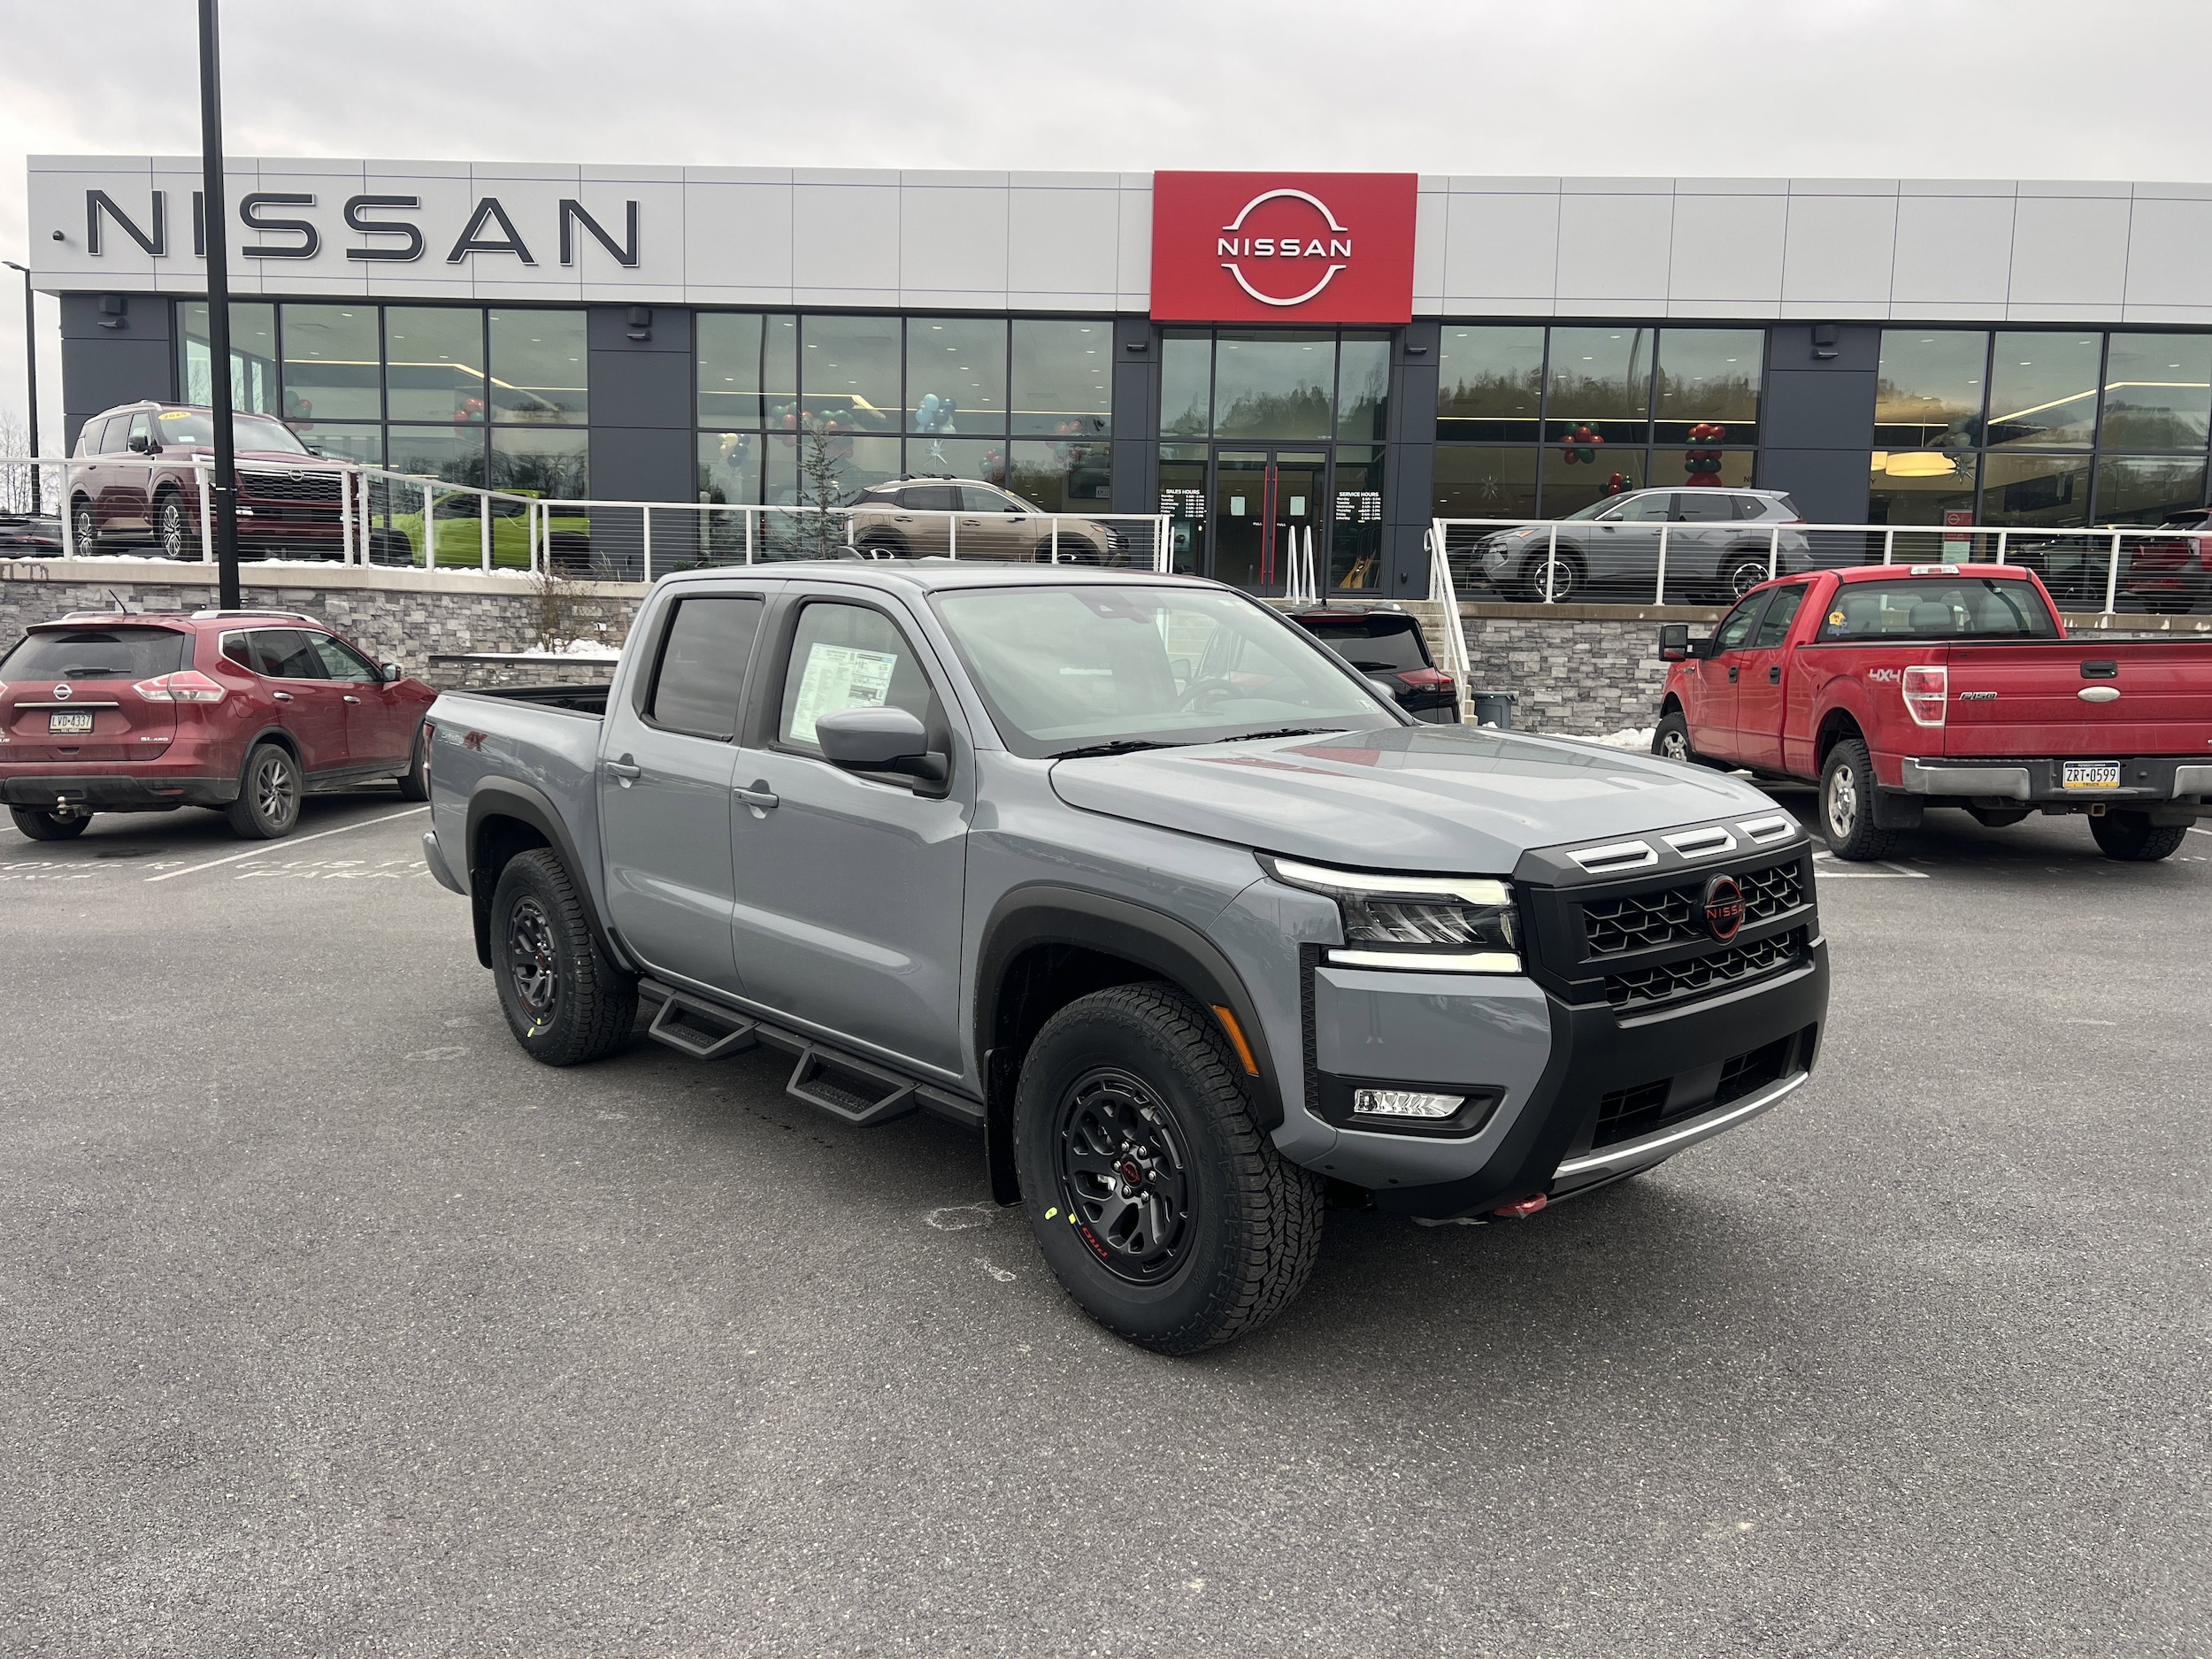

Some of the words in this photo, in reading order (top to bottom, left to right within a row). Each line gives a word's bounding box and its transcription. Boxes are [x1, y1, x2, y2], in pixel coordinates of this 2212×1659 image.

[86, 188, 640, 267] NISSAN
[1217, 237, 1352, 257] NISSAN
[1869, 668, 1901, 684] 4X4
